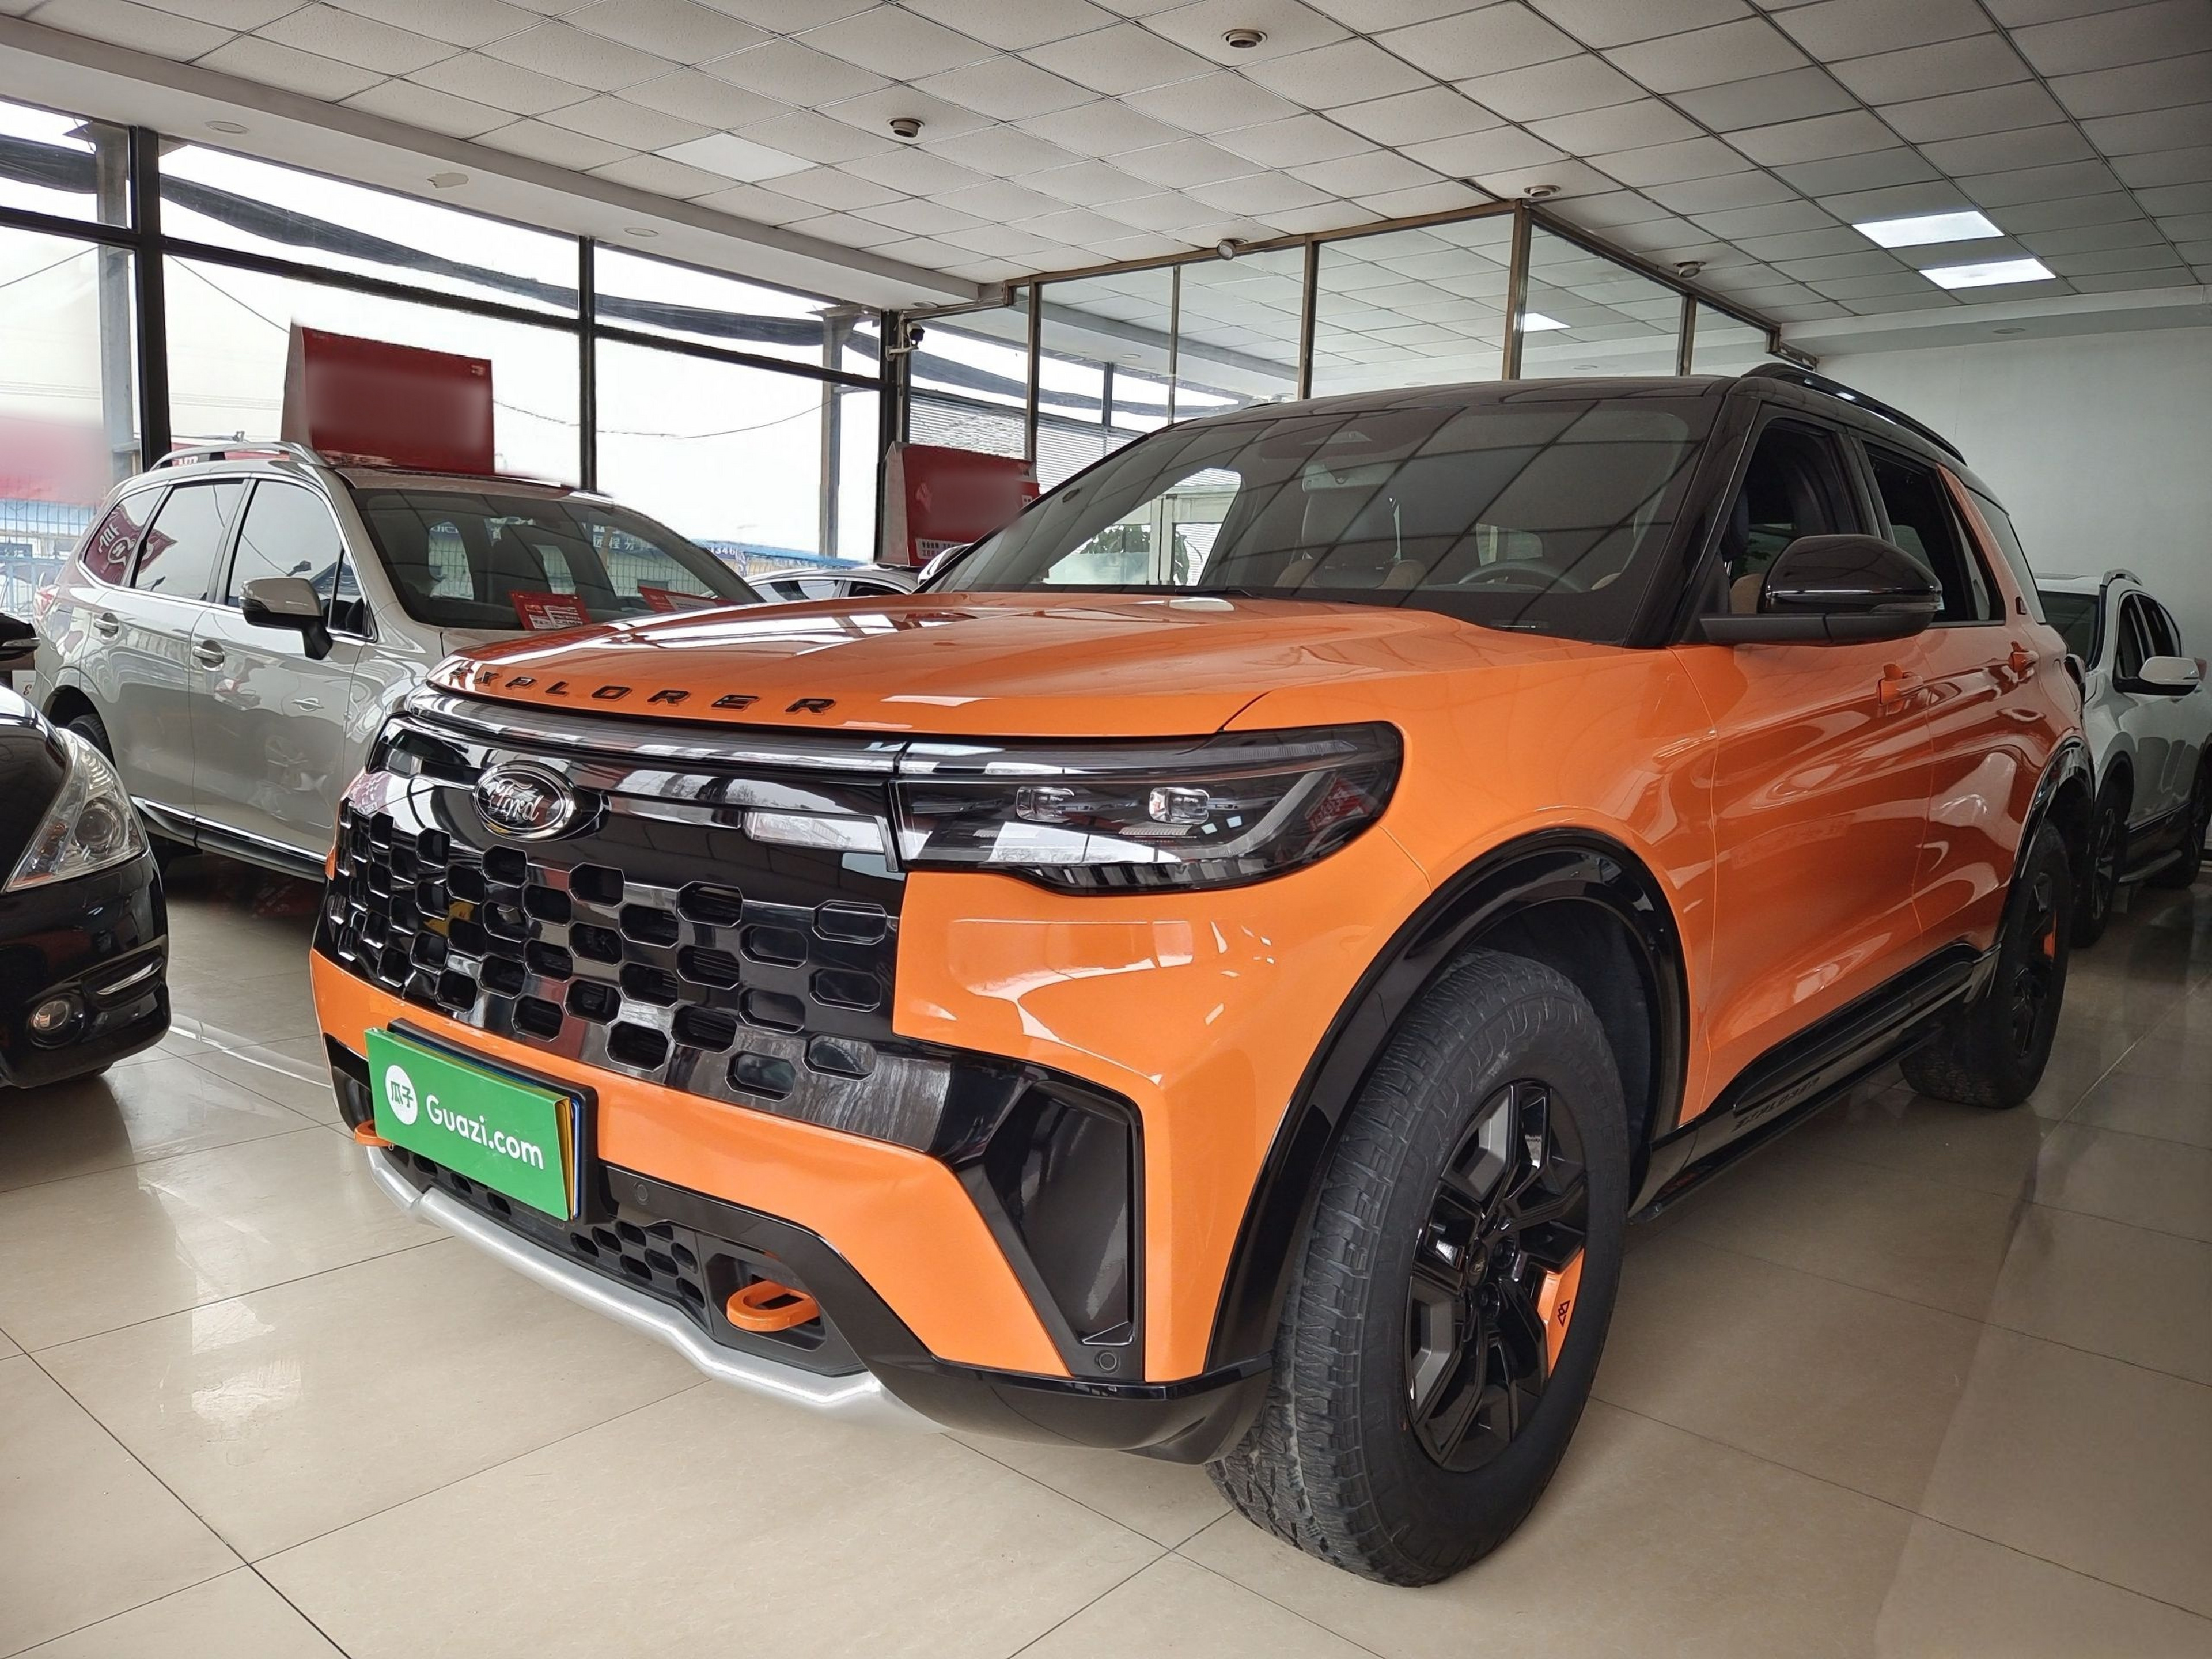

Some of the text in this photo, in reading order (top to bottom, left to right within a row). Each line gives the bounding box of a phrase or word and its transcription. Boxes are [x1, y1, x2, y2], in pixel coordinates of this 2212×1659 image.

[449, 666, 837, 714] EXPLORER
[488, 779, 540, 821] Ford
[390, 1080, 414, 1109] 瓜子
[426, 1094, 544, 1170] Guazi.com
